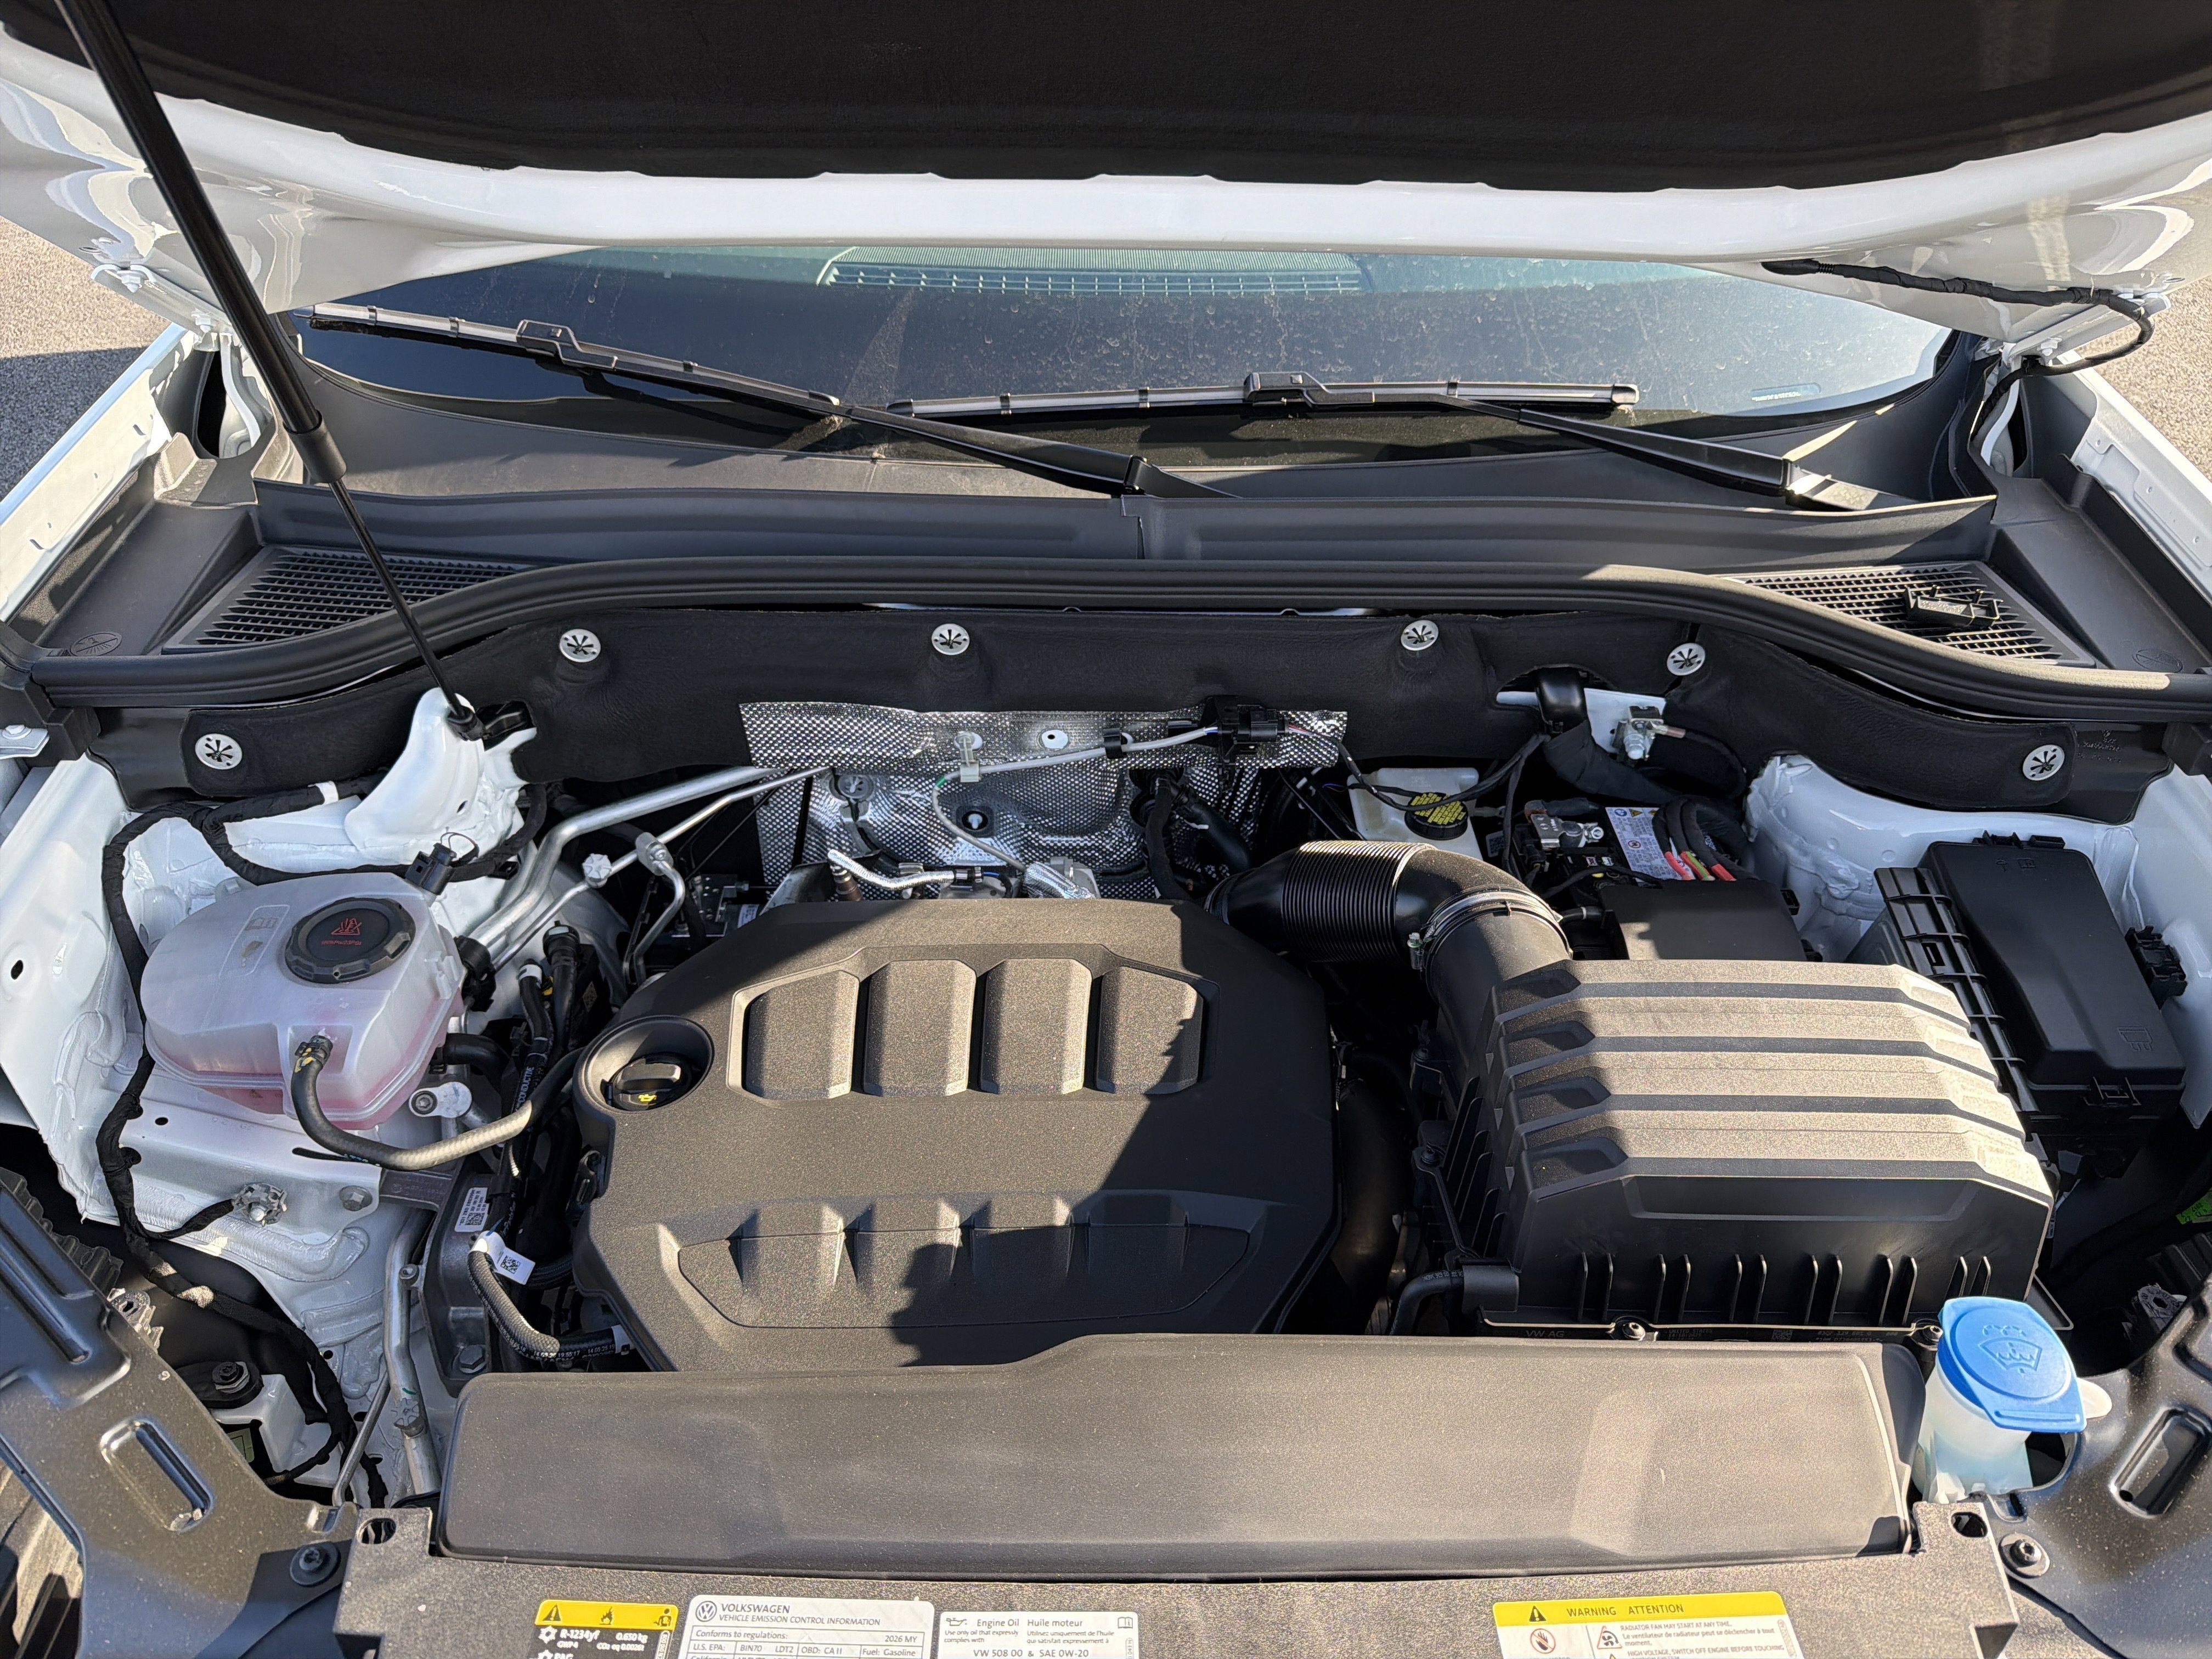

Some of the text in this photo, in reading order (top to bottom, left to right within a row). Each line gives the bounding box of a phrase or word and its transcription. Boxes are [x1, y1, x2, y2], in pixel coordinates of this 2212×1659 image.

[721, 1604, 791, 1613] VOLKSWAGEN
[1566, 1604, 1684, 1617] WARNING ATTENTION
[827, 1617, 881, 1626] INFORMATION
[977, 1619, 1006, 1629] Engine
[560, 1629, 601, 1643] R-1234yf
[637, 1633, 648, 1644] kg
[696, 1630, 732, 1638] Conforms
[743, 1631, 788, 1640] regulations:
[883, 1649, 916, 1657] Gasoline
[992, 1649, 1008, 1657] 508
[1011, 1649, 1023, 1657] 00
[1039, 1649, 1056, 1657] SAE
[1058, 1649, 1089, 1657] 0W-20
